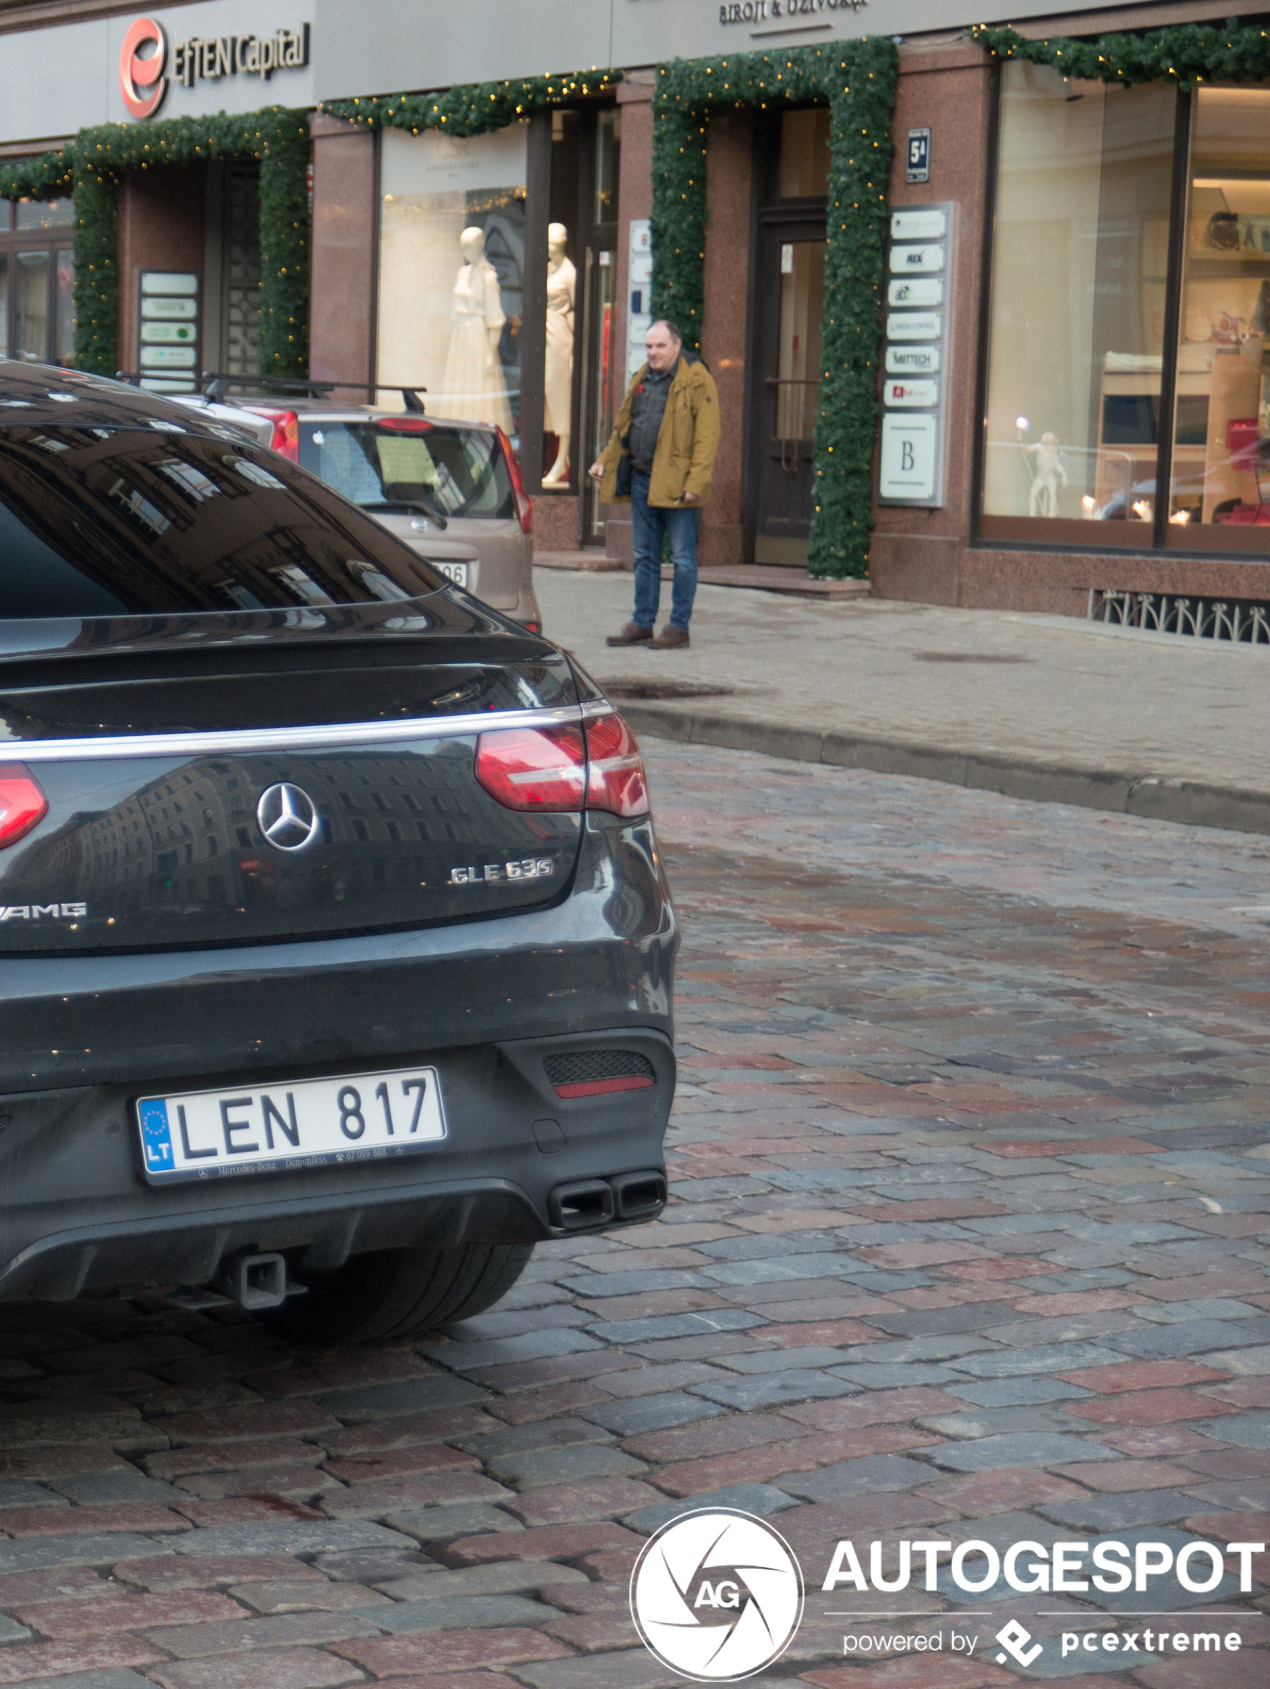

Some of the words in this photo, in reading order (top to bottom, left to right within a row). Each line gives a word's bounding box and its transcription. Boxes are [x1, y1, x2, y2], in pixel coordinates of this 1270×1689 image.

[719, 1, 767, 24] BIROJI
[771, 1, 781, 16] &
[172, 36, 237, 87] EfTEN
[235, 22, 311, 80] Capital
[901, 440, 915, 471] B
[451, 864, 500, 885] GLE
[0, 902, 87, 921] AMG
[176, 1091, 301, 1160] LEN
[336, 1077, 427, 1141] 817
[146, 1142, 171, 1162] LT
[217, 1161, 277, 1177] Mercedes-Benz
[285, 1154, 327, 1169] Domenikss
[346, 1151, 355, 1161] 67
[356, 1148, 371, 1160] 099
